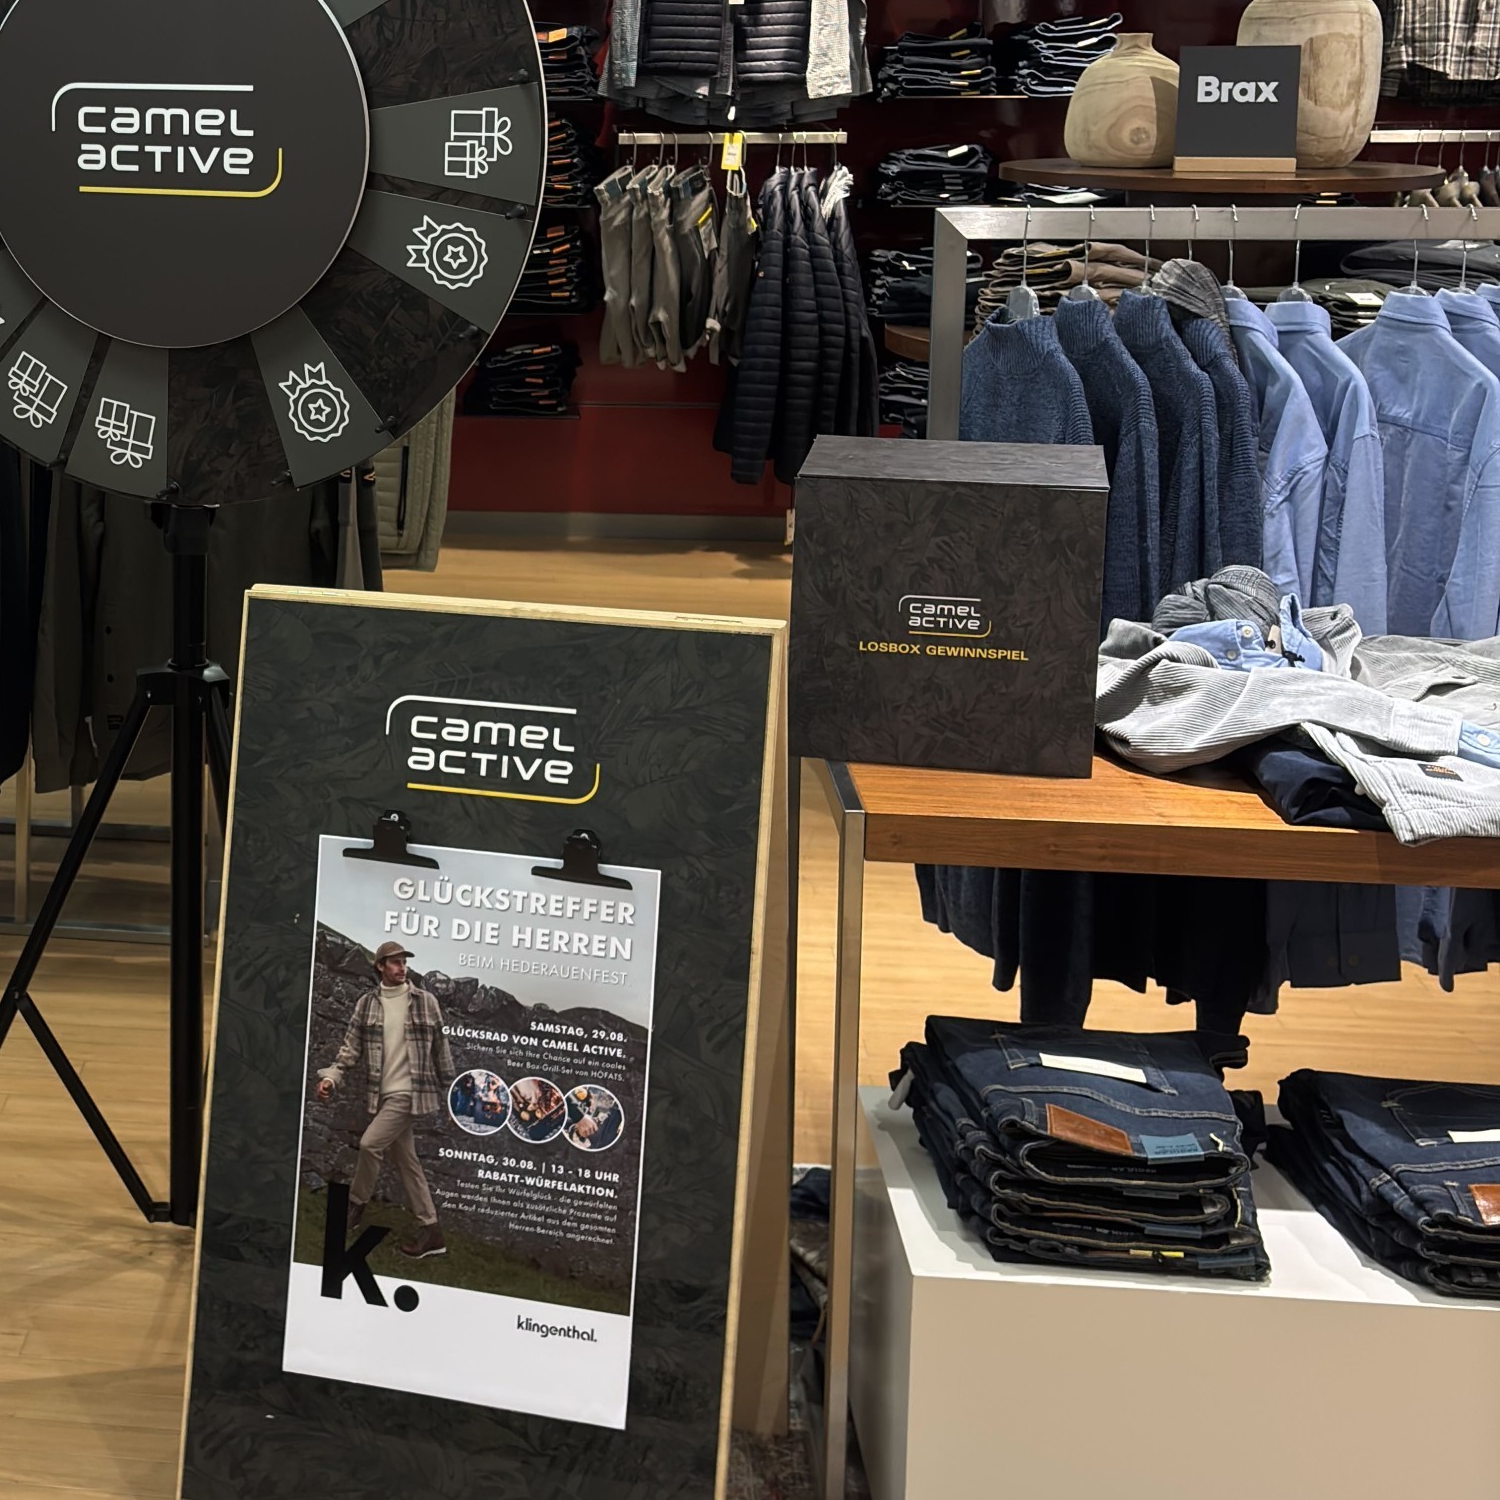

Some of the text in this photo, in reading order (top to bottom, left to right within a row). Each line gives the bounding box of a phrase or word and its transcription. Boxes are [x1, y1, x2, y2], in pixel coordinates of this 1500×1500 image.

[1197, 75, 1279, 102] Brax
[859, 641, 1029, 661] LOSBOX GEWINNSPIEL
[393, 876, 636, 926] GLÜCKSTREFFER
[384, 907, 632, 961] FÜR DIE HERREN
[459, 953, 631, 987] BEIM HEDERAUENFEST.
[442, 1025, 626, 1059] GLÜCKSRAD VON CAMEL ACTIVE.
[530, 1021, 628, 1042] SAMSTAG, 29.08.
[466, 1043, 626, 1070] Sichern Sie sich Ihre Chance auf ein cooles
[507, 1059, 524, 1068] Beer
[575, 1069, 589, 1077] von
[438, 1147, 498, 1166] SONNTAG,
[502, 1156, 537, 1170] 30.08.
[551, 1164, 564, 1175] 13
[577, 1168, 591, 1179] 18
[594, 1170, 619, 1183] UHR
[477, 1169, 618, 1199] RABATT-WÜRFELAKTION.
[321, 1182, 420, 1312] k.
[517, 1315, 597, 1342] klingenthal.
